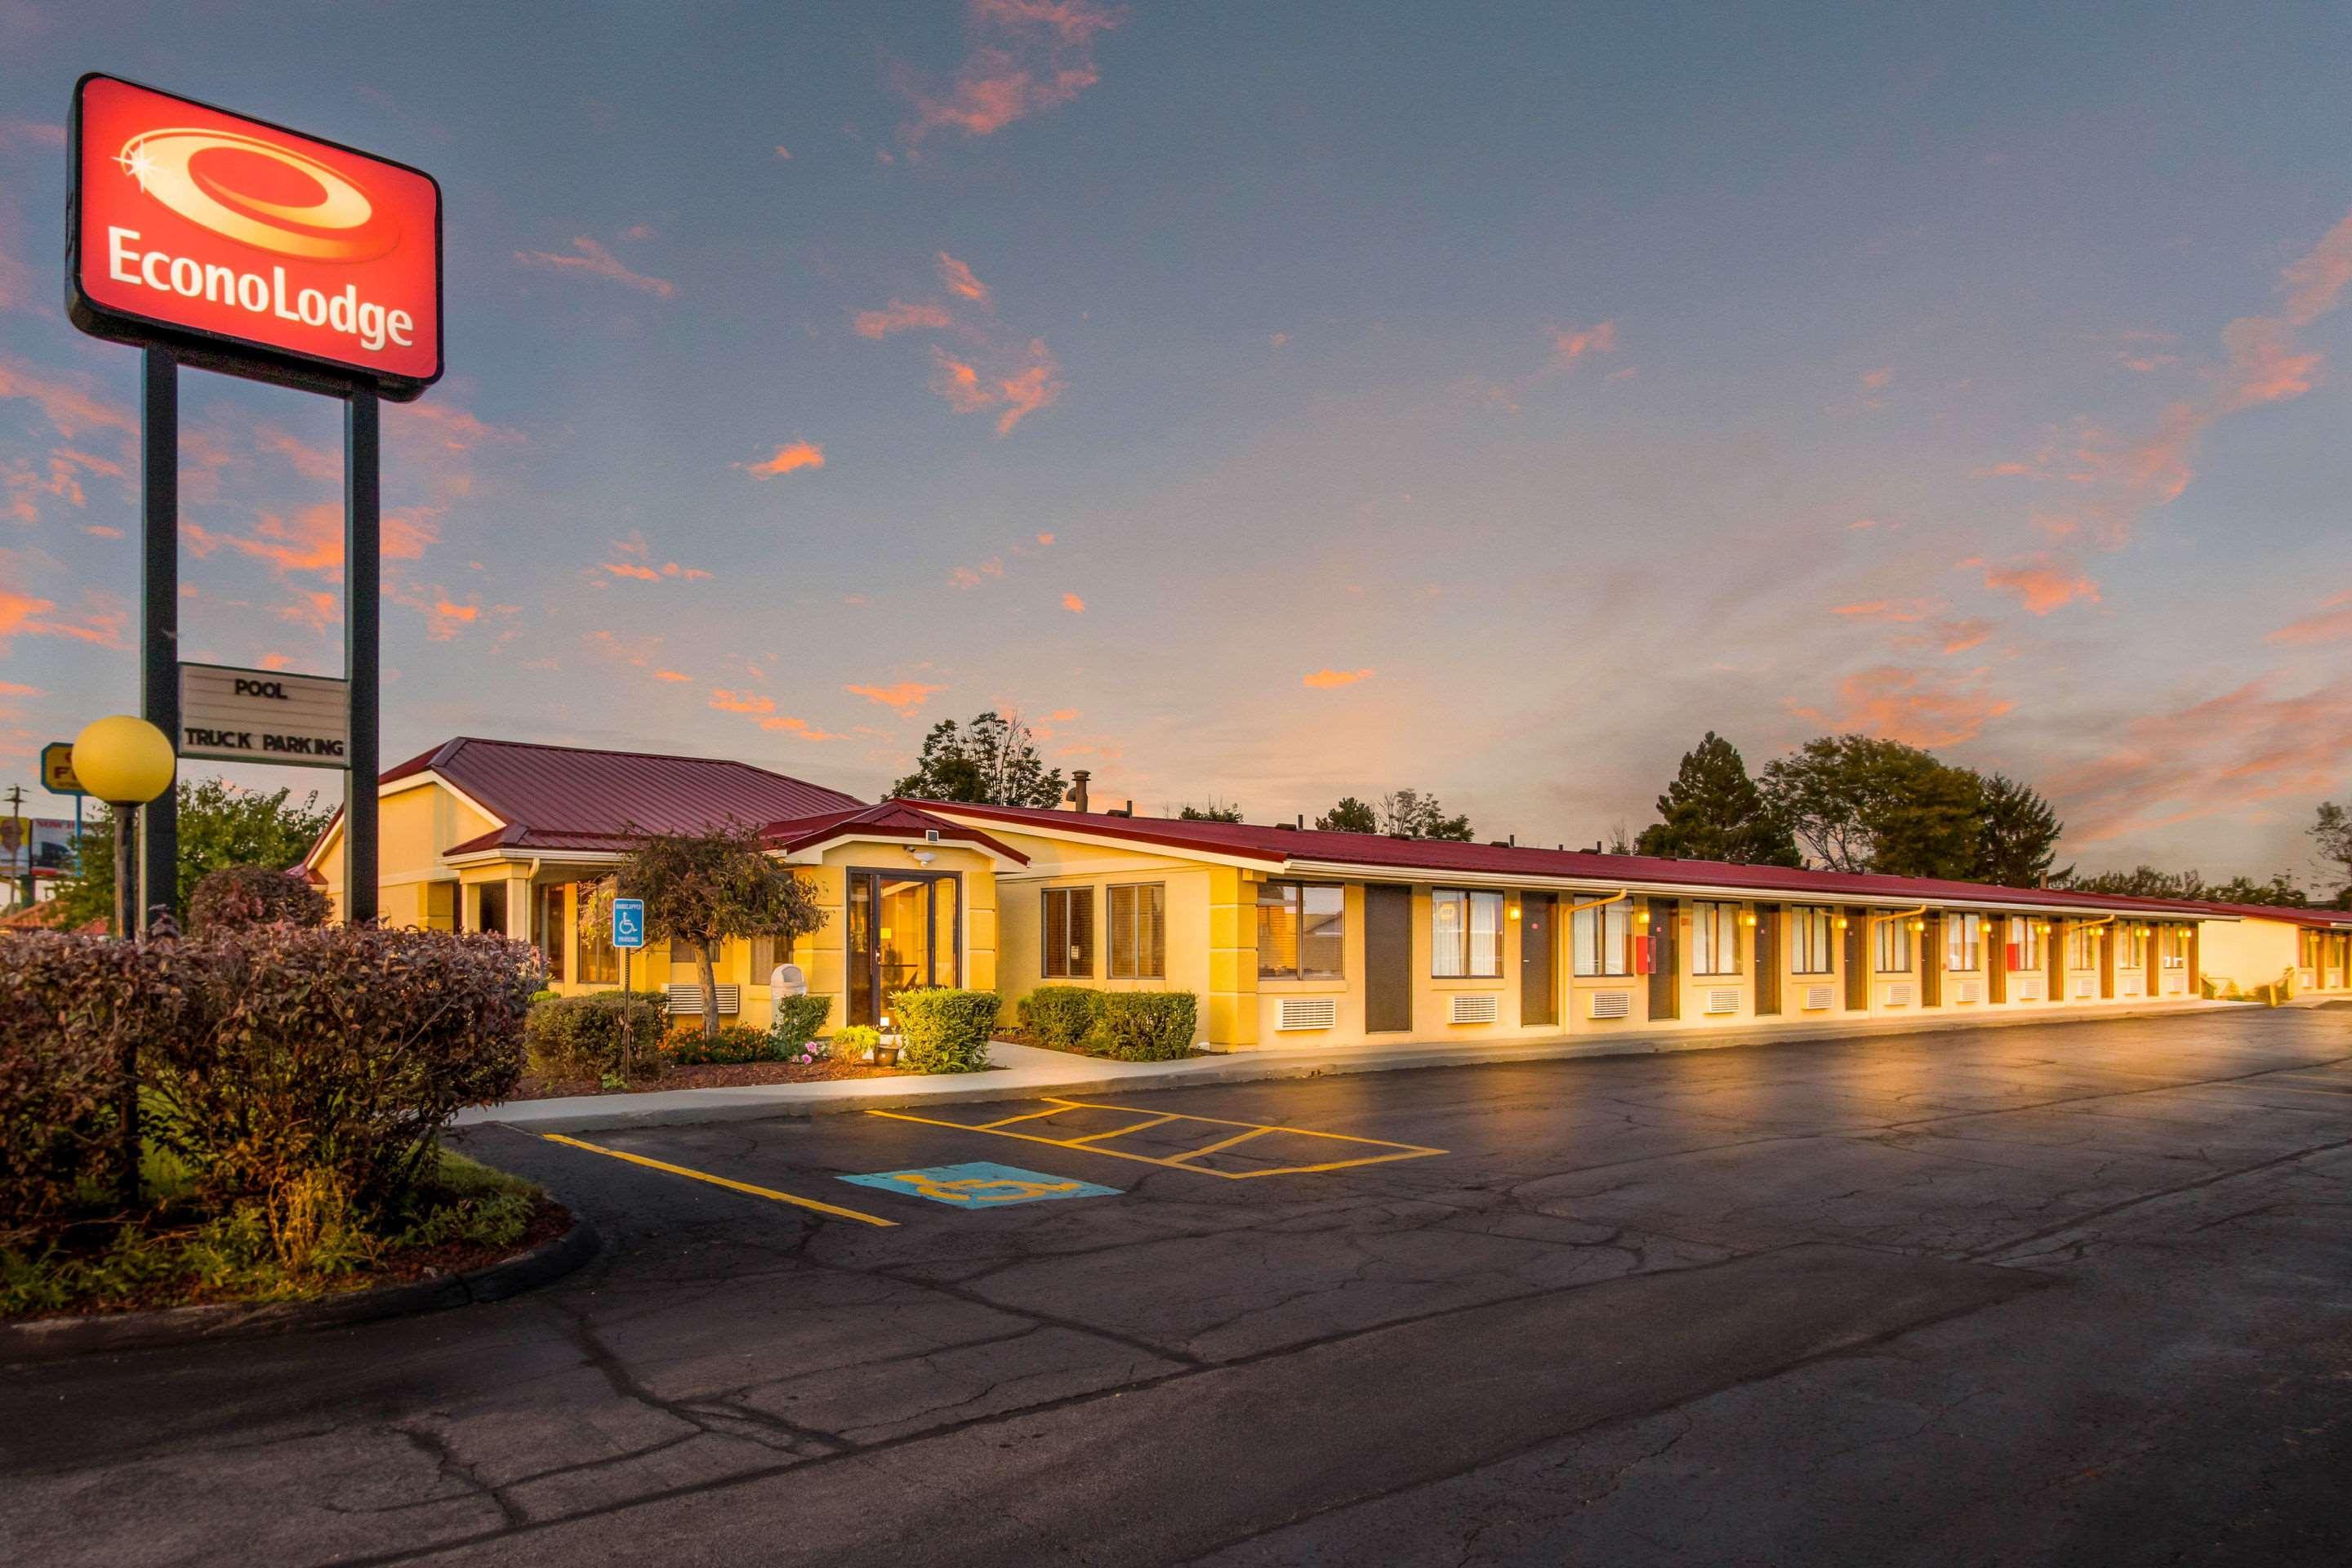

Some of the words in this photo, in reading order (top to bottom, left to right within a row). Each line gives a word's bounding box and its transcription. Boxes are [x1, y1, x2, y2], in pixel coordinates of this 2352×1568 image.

[108, 225, 413, 350] EconoLodge
[234, 679, 288, 700] POOL
[185, 728, 252, 749] TRUCK
[262, 734, 344, 756] PARKING
